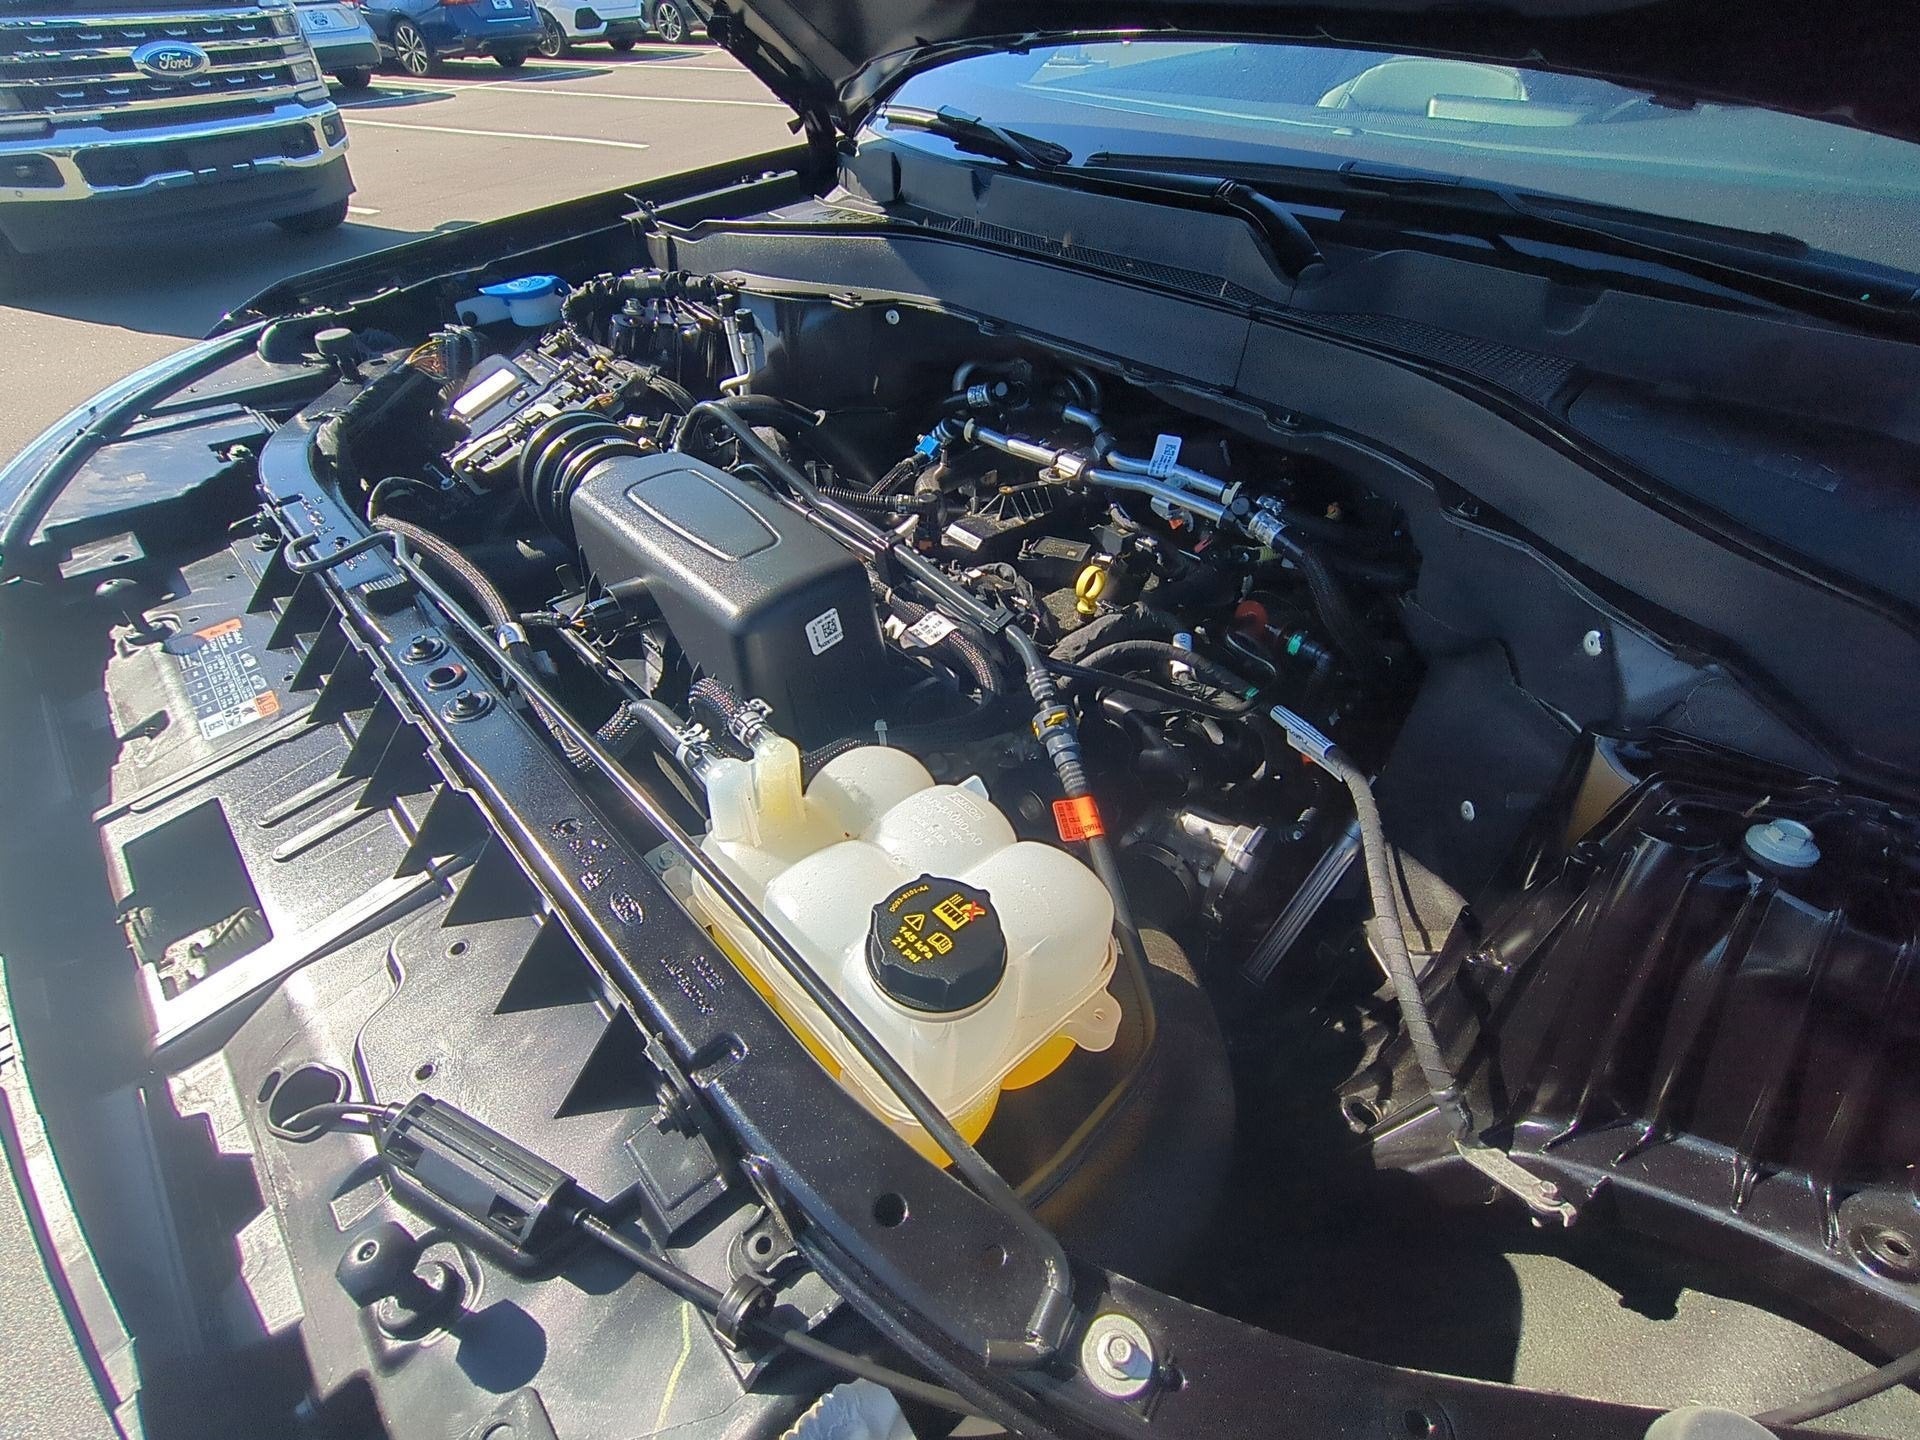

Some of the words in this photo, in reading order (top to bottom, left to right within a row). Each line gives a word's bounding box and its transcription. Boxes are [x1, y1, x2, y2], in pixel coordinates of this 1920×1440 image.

[159, 52, 193, 70] Ford
[891, 936, 906, 949] 21
[902, 948, 921, 963] psi
[899, 926, 918, 943] 145
[914, 940, 933, 959] kPa
